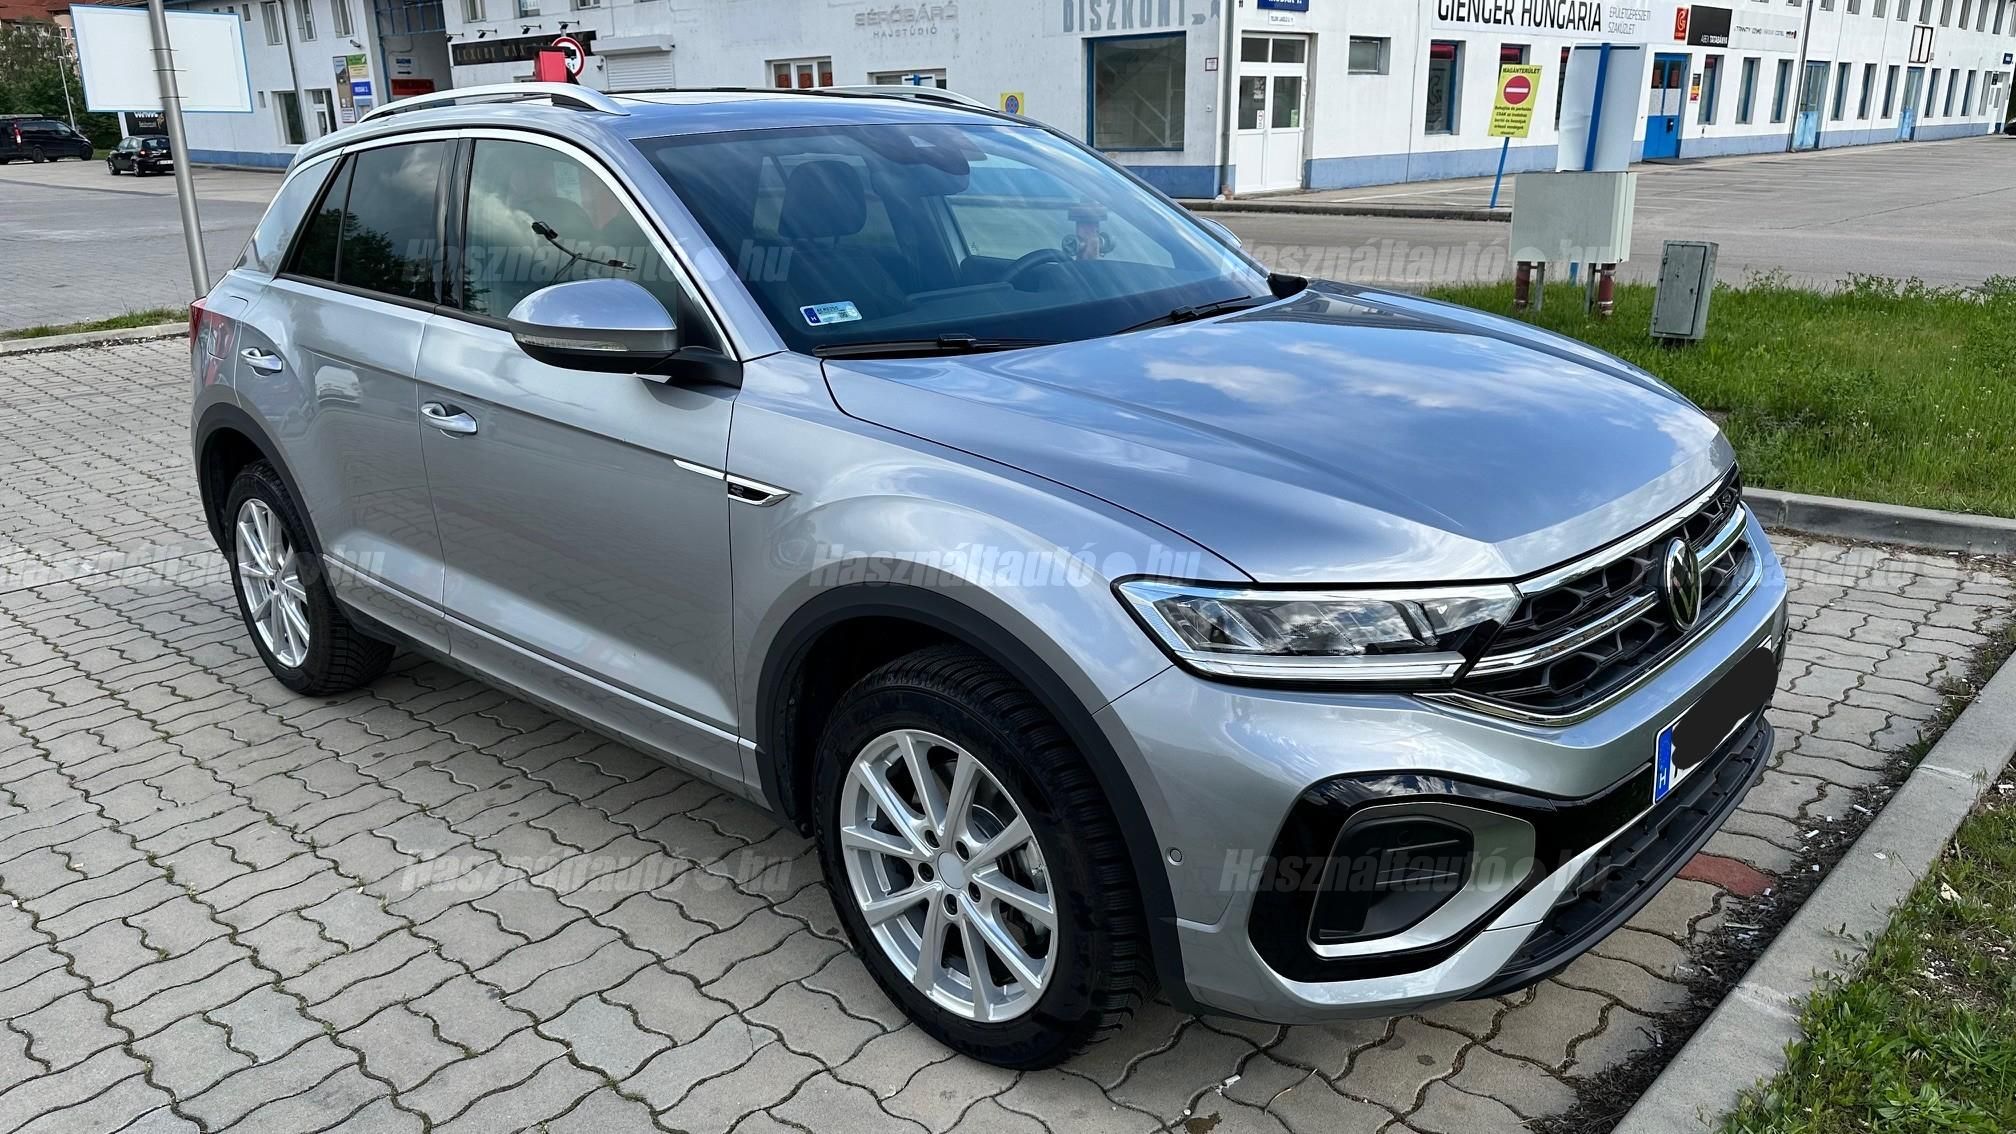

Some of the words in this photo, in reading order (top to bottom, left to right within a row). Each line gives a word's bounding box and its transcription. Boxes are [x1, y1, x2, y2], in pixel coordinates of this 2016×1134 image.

[1438, 0, 1514, 25] GIENGER
[873, 23, 937, 38] HAJSTÚDIÓ
[1658, 767, 1667, 789] H
